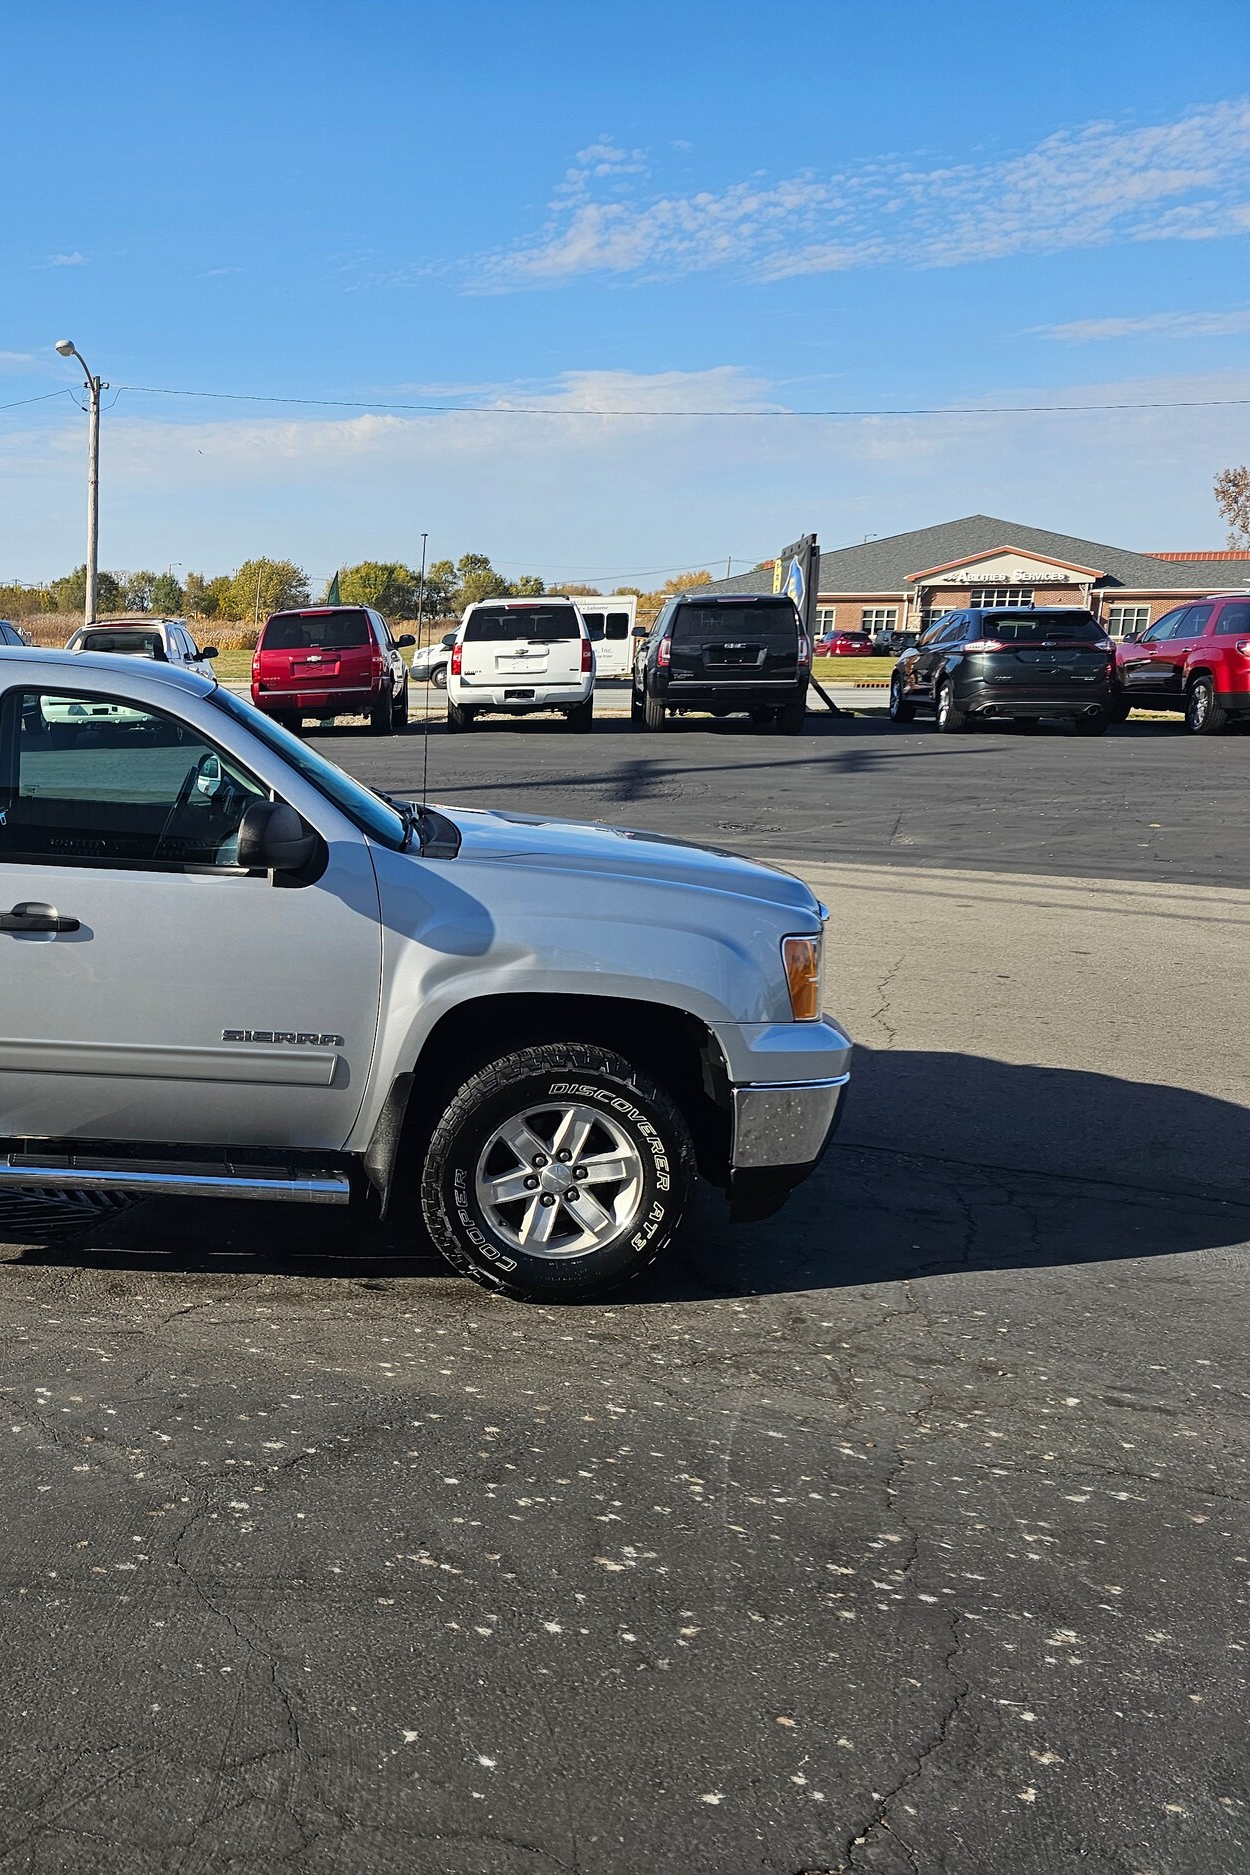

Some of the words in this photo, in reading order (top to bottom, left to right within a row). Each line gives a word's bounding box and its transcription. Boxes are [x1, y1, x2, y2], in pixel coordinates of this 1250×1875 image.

[1013, 569, 1066, 581] SERVICES
[221, 1029, 345, 1047] SIERRA
[548, 1083, 670, 1192] DISCOVERER
[631, 1200, 665, 1252] AT3
[454, 1168, 518, 1272] COOPER
